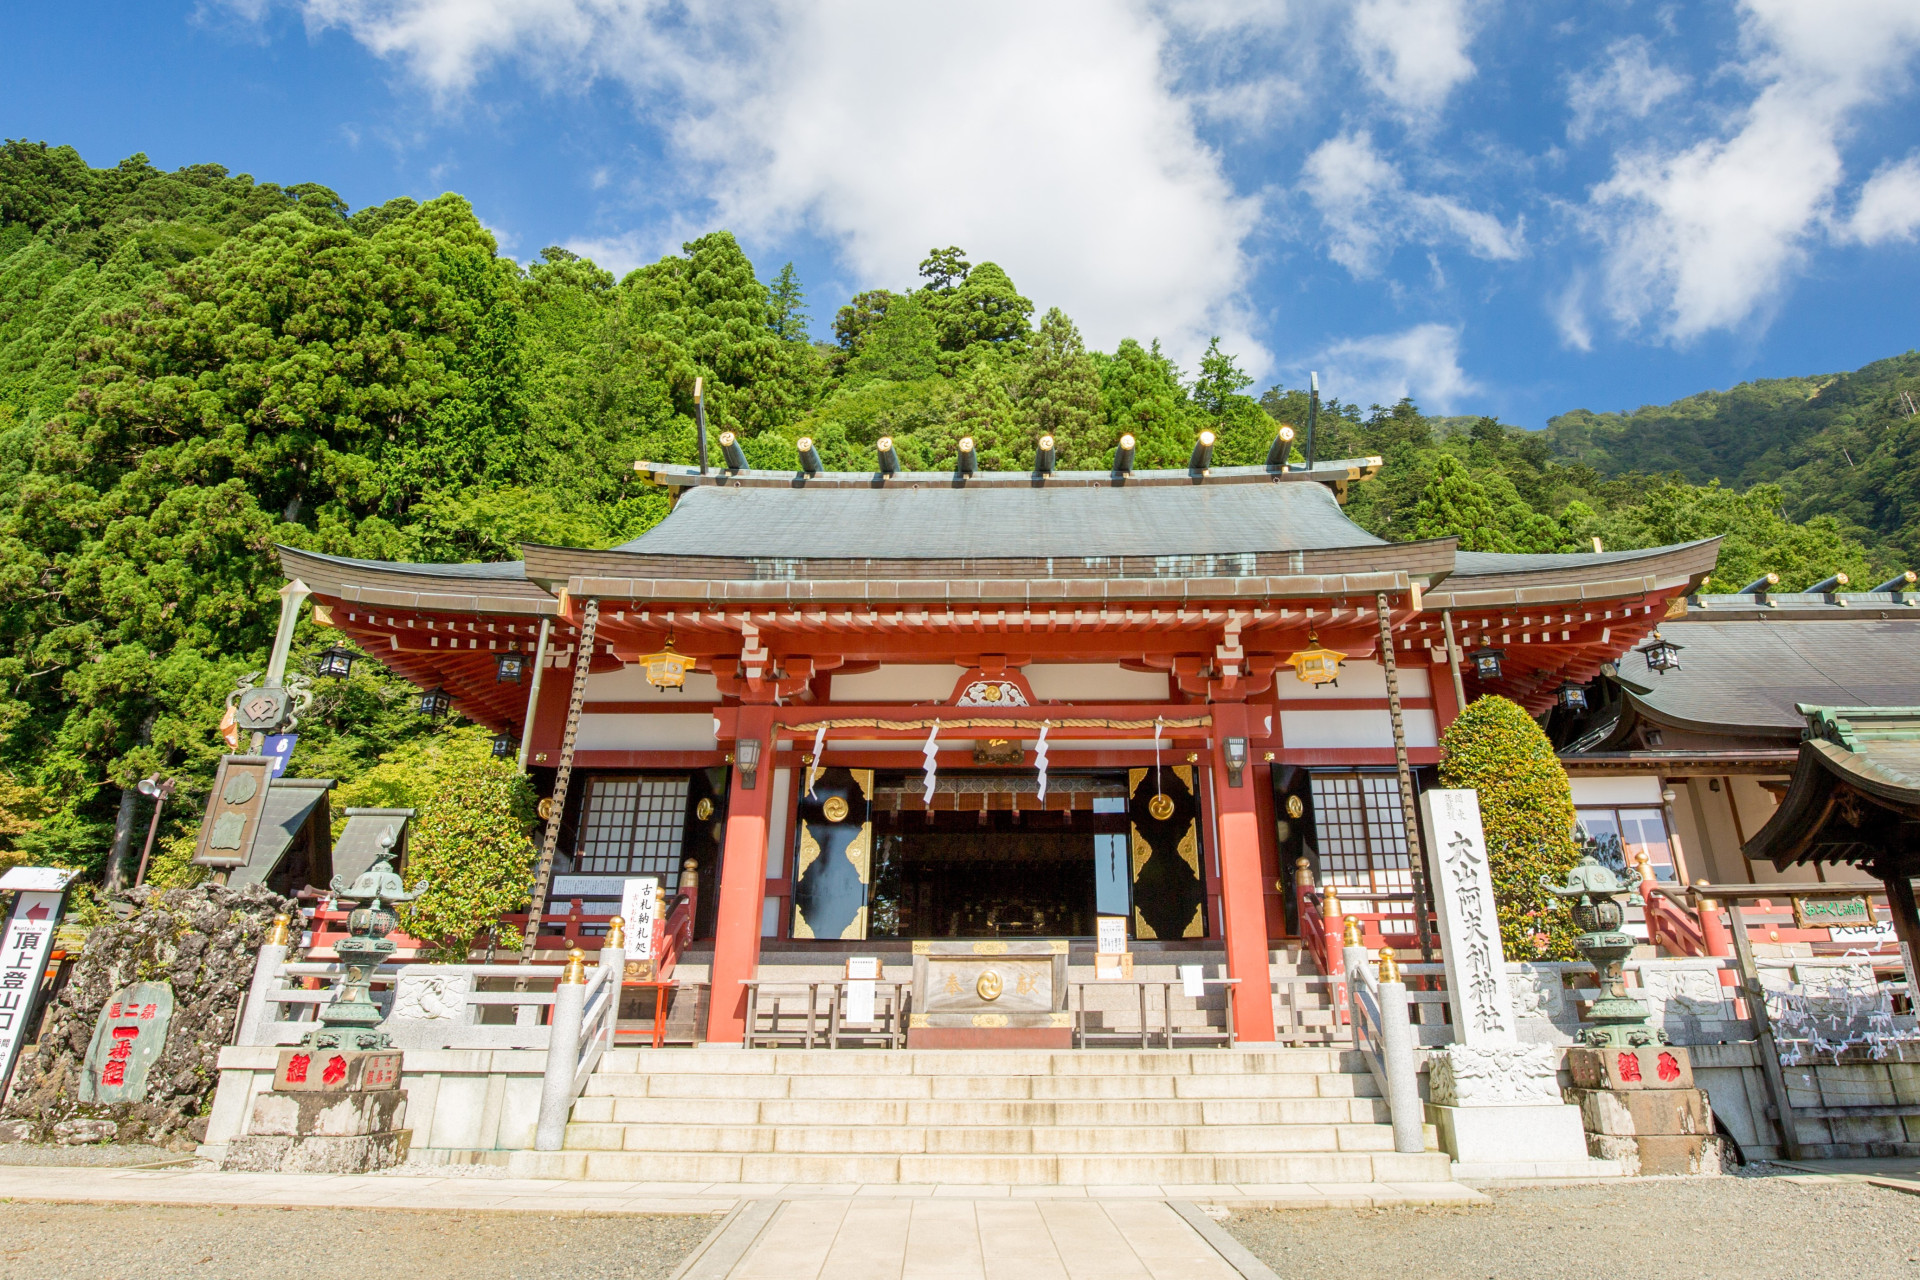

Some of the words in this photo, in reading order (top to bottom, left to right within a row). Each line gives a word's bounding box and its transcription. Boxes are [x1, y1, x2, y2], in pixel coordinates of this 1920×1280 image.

[634, 884, 653, 953] 古札納札処
[1445, 830, 1505, 1034] 大山阿夫利神社
[0, 931, 42, 1031] 頂上登山口
